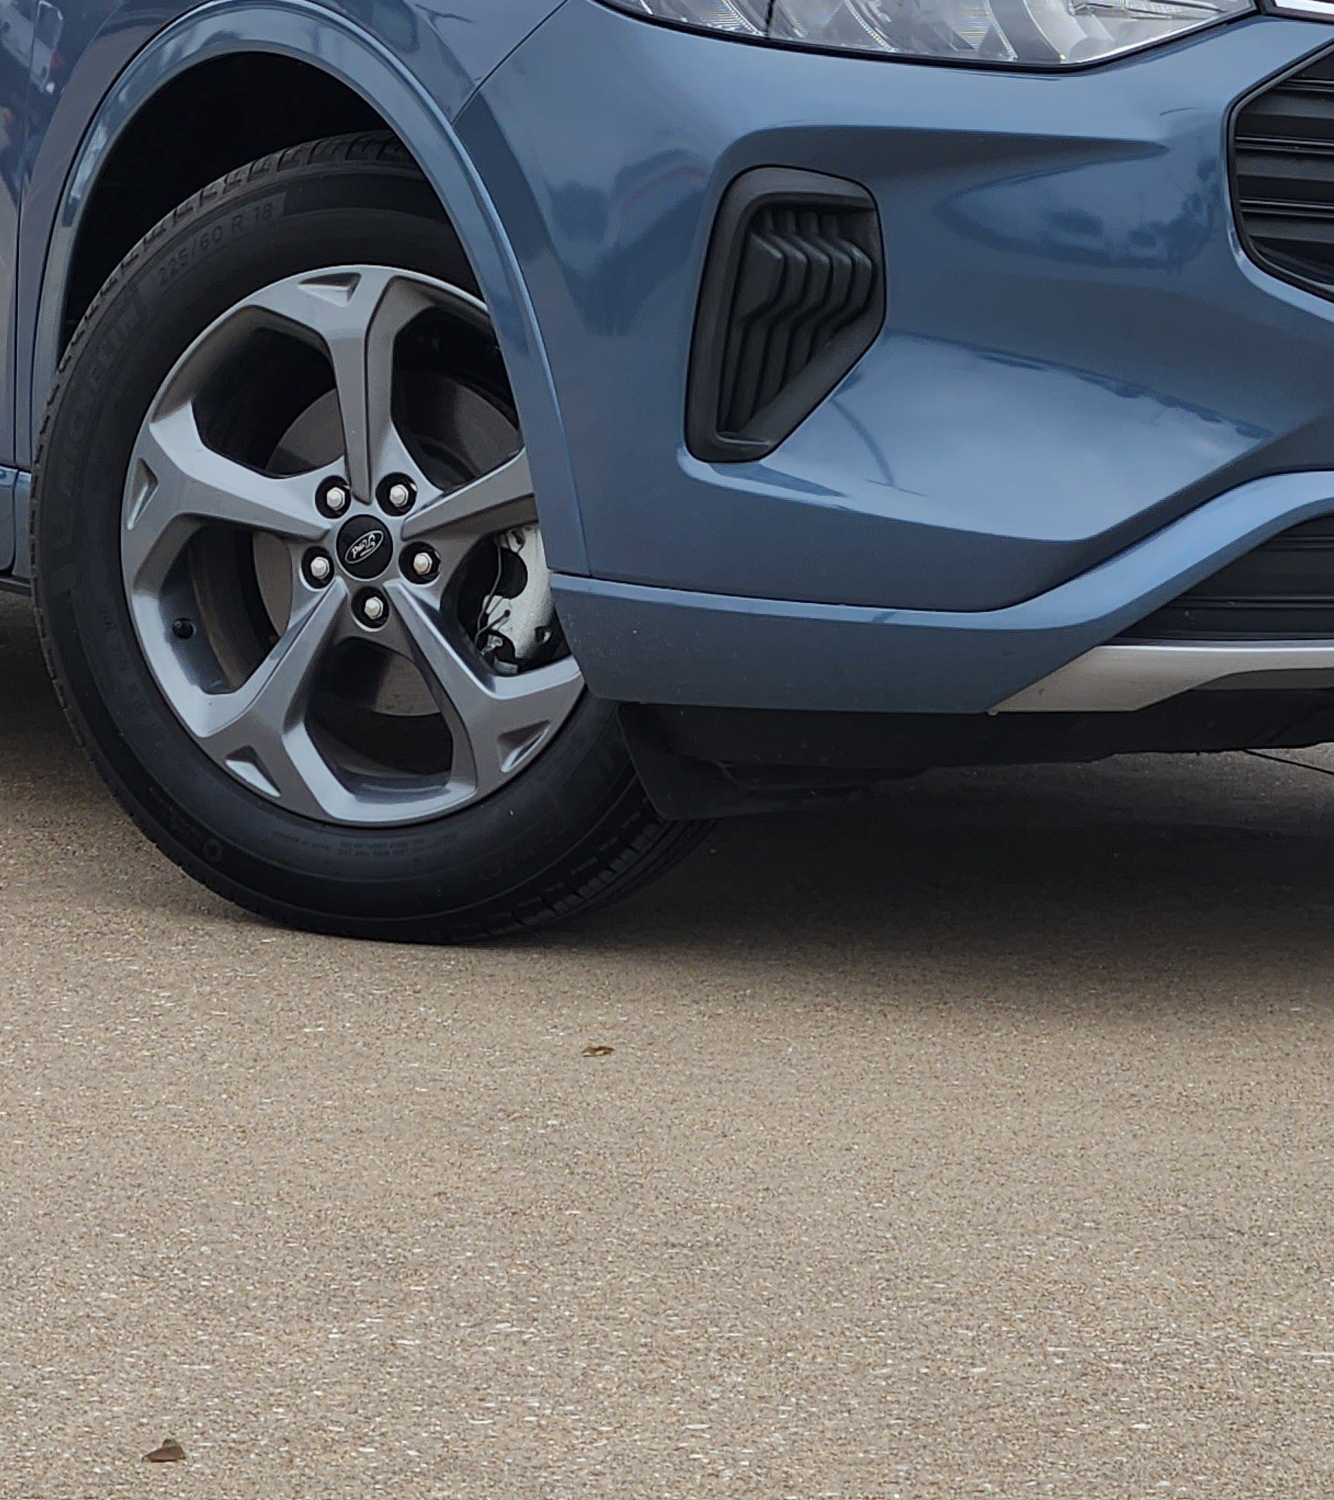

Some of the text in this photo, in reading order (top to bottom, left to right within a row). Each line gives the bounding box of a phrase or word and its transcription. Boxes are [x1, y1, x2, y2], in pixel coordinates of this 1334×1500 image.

[158, 202, 273, 286] 225/60 R 18
[351, 534, 375, 558] Ford
